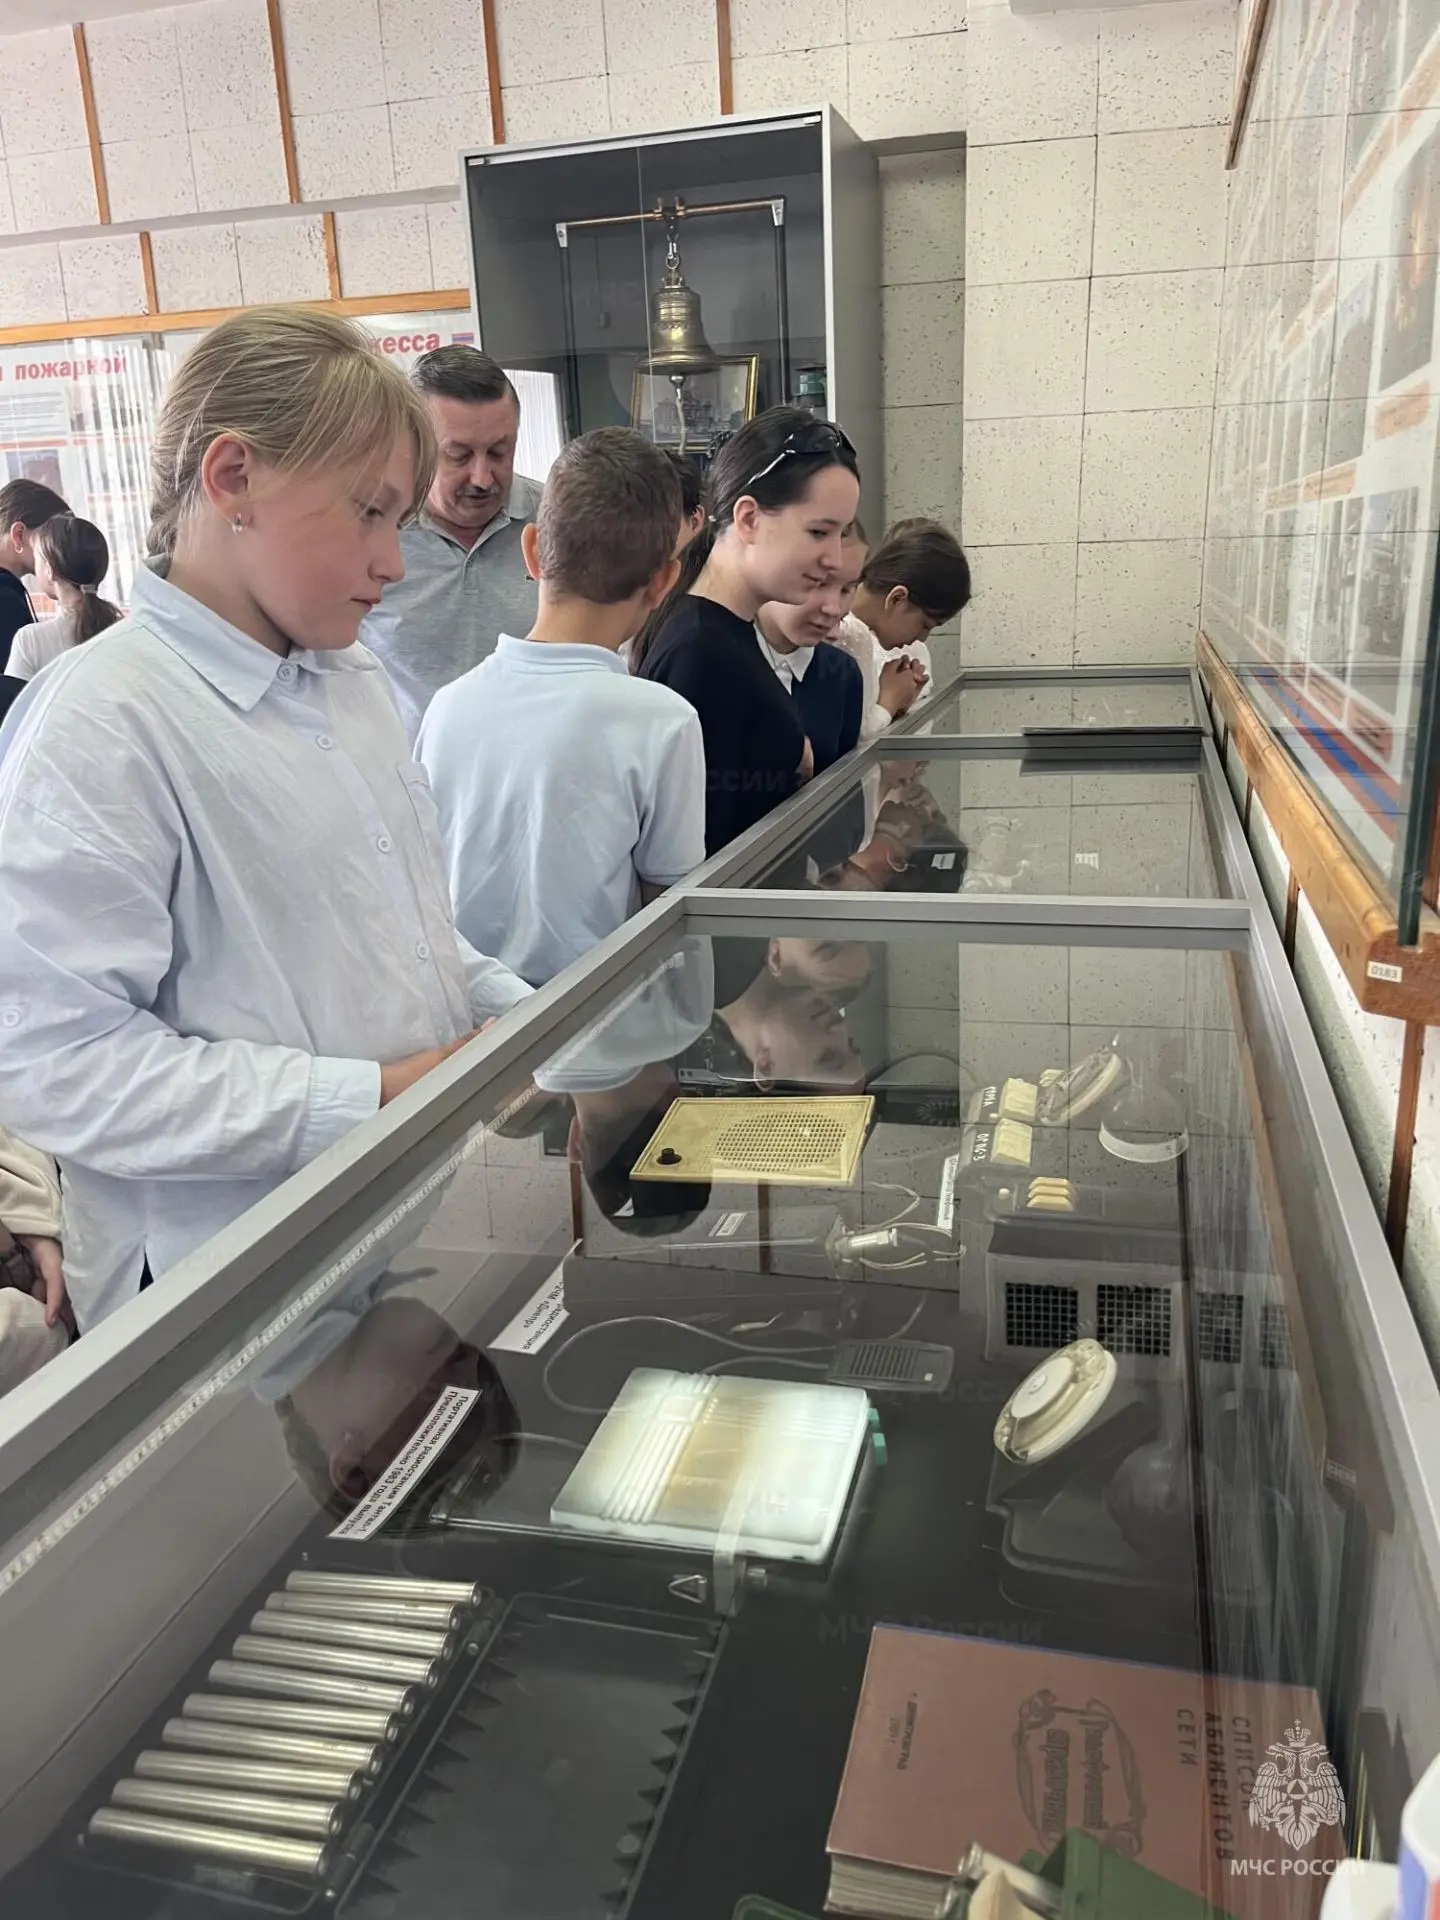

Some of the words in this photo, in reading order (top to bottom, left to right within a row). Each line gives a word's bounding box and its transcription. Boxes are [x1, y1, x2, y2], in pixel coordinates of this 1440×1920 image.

[15, 349, 126, 380] пожарной
[399, 1391, 458, 1465] Предположительно
[429, 1396, 470, 1446] Портативная
[371, 1484, 388, 1504] года
[388, 1446, 433, 1499] радиостанция
[337, 1503, 372, 1535] выпуска
[1177, 1709, 1199, 1767] СЕТИ
[1204, 1712, 1235, 1860] АБОНЕНТОВ
